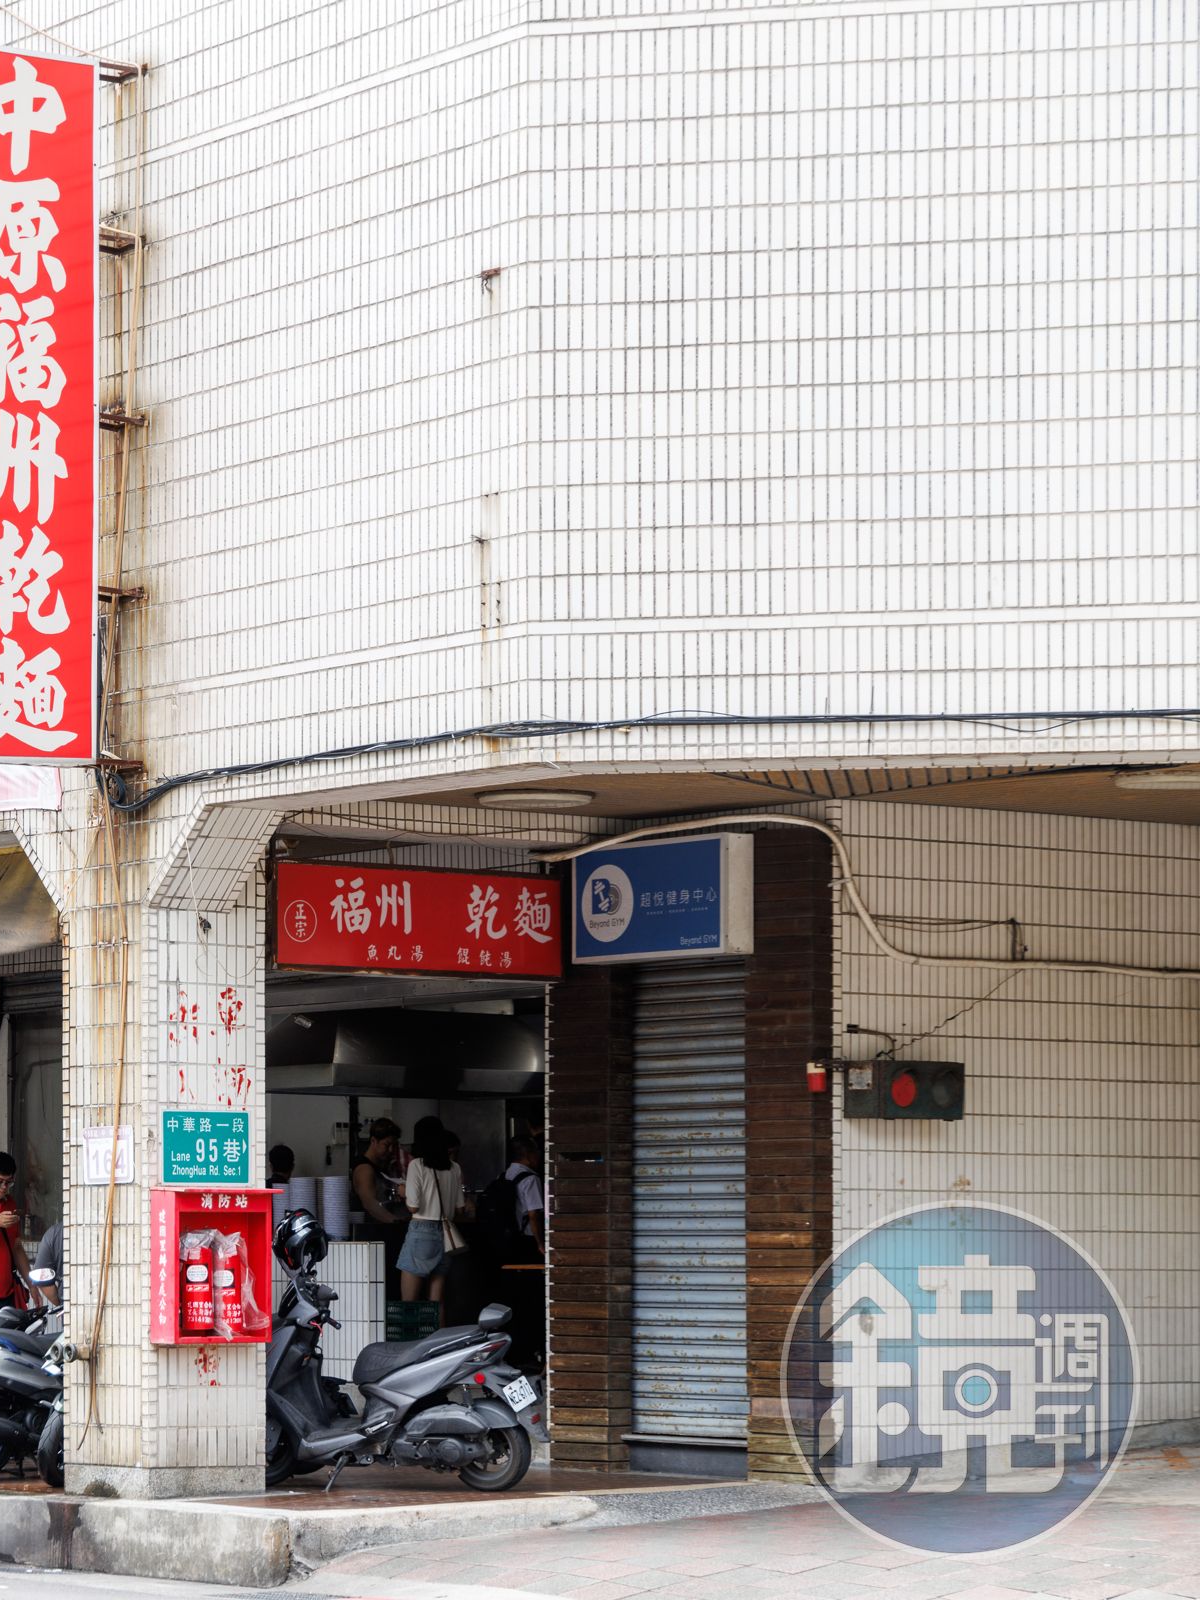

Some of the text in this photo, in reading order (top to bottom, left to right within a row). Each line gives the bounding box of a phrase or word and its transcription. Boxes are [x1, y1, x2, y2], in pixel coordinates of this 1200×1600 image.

[294, 903, 307, 938] 正宗
[589, 918, 625, 930] Beyond GYM
[680, 934, 718, 946] Beyond GYM
[367, 944, 424, 962] 魚丸湯
[167, 1116, 244, 1133] 中華路一段
[171, 1150, 191, 1162] Lane
[172, 1164, 206, 1178] ZhongHua
[209, 1164, 220, 1176] Rd.
[201, 1193, 248, 1210] 消防站
